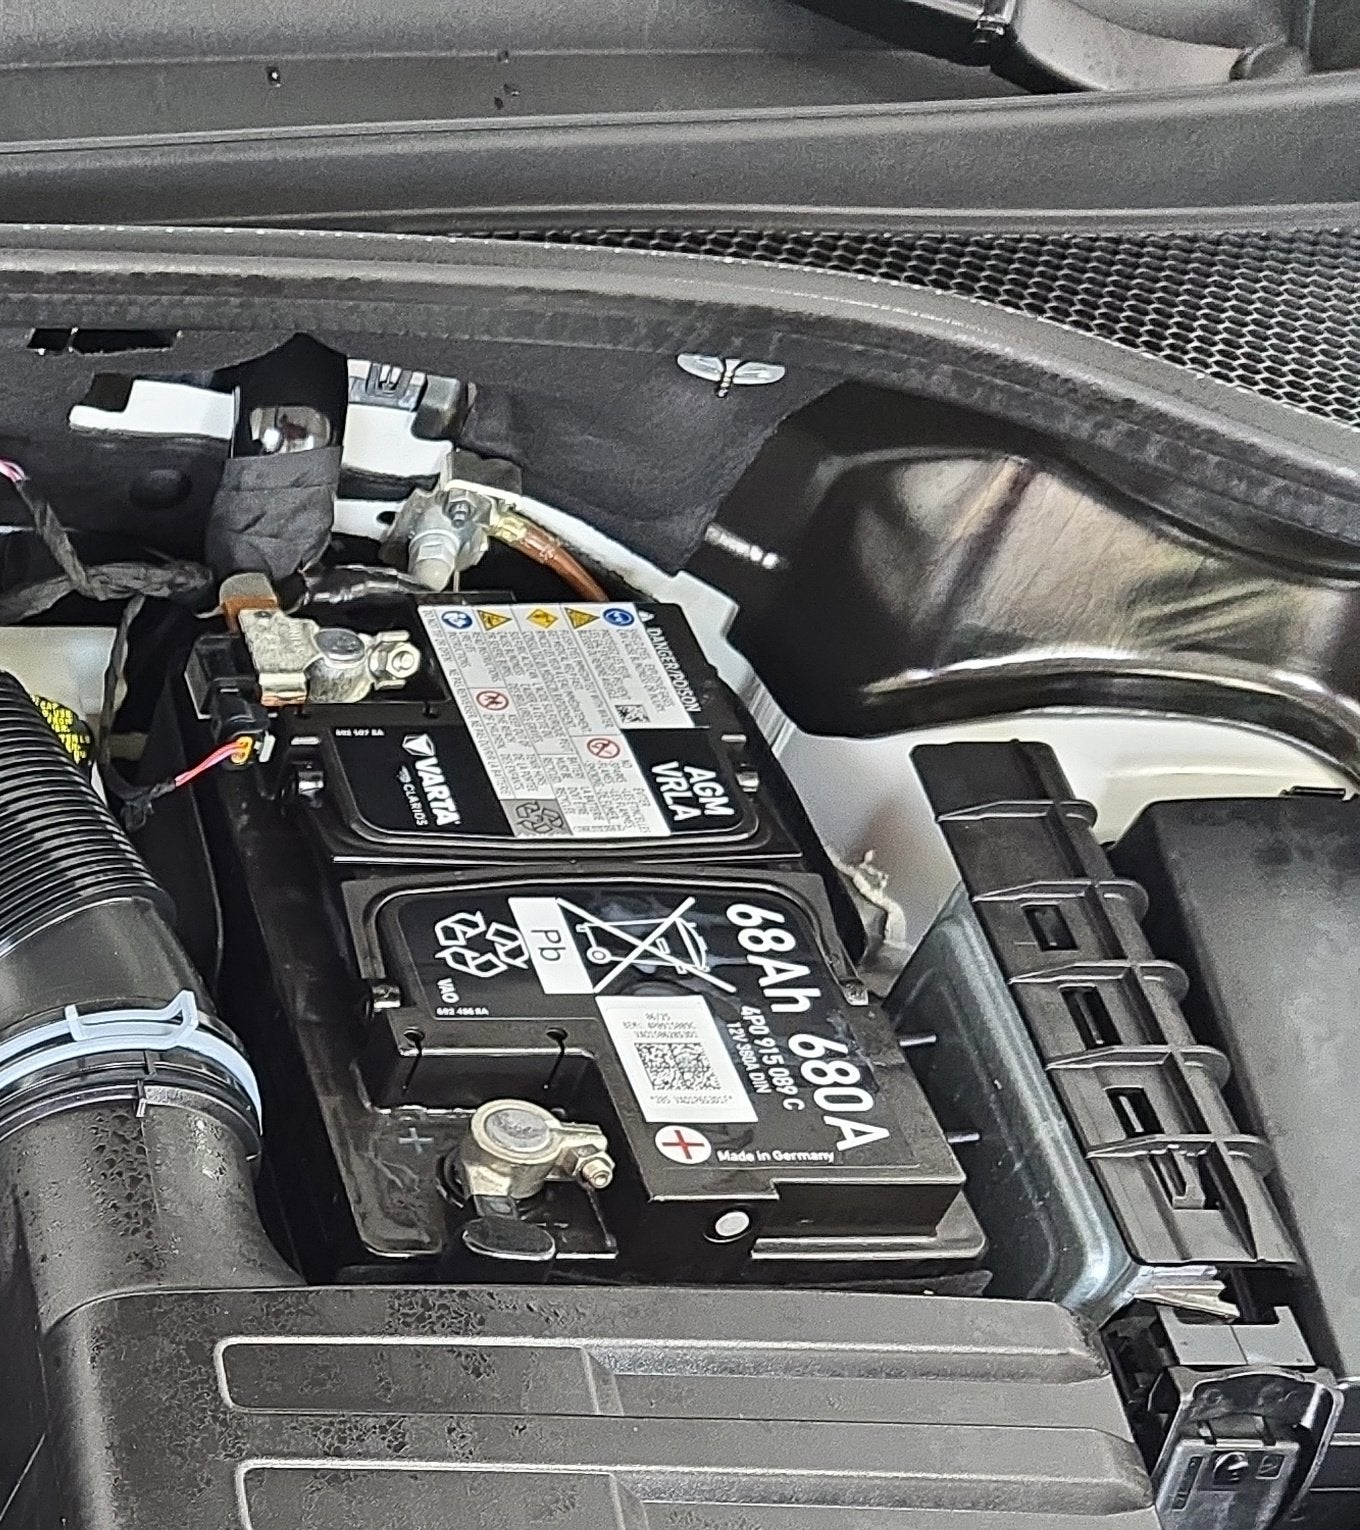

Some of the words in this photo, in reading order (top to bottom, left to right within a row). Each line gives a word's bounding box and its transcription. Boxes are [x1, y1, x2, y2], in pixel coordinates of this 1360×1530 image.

[647, 628, 701, 713] DANGER/POISON
[403, 783, 429, 827] CLARIOS
[415, 757, 459, 826] VARTA
[651, 761, 702, 820] VRLA
[684, 766, 734, 815] AGM
[530, 929, 567, 961] Pb
[726, 903, 822, 1013] 68Ah
[788, 1033, 890, 1152] 680A
[741, 1005, 769, 1035] 4P0
[726, 1022, 749, 1042] 12V
[748, 1072, 772, 1094] DIN
[754, 1036, 784, 1066] 915
[768, 1067, 798, 1097] 089
[783, 1098, 805, 1111] C
[716, 1149, 755, 1162] Made
[756, 1149, 772, 1162] in
[772, 1149, 835, 1164] Germany
